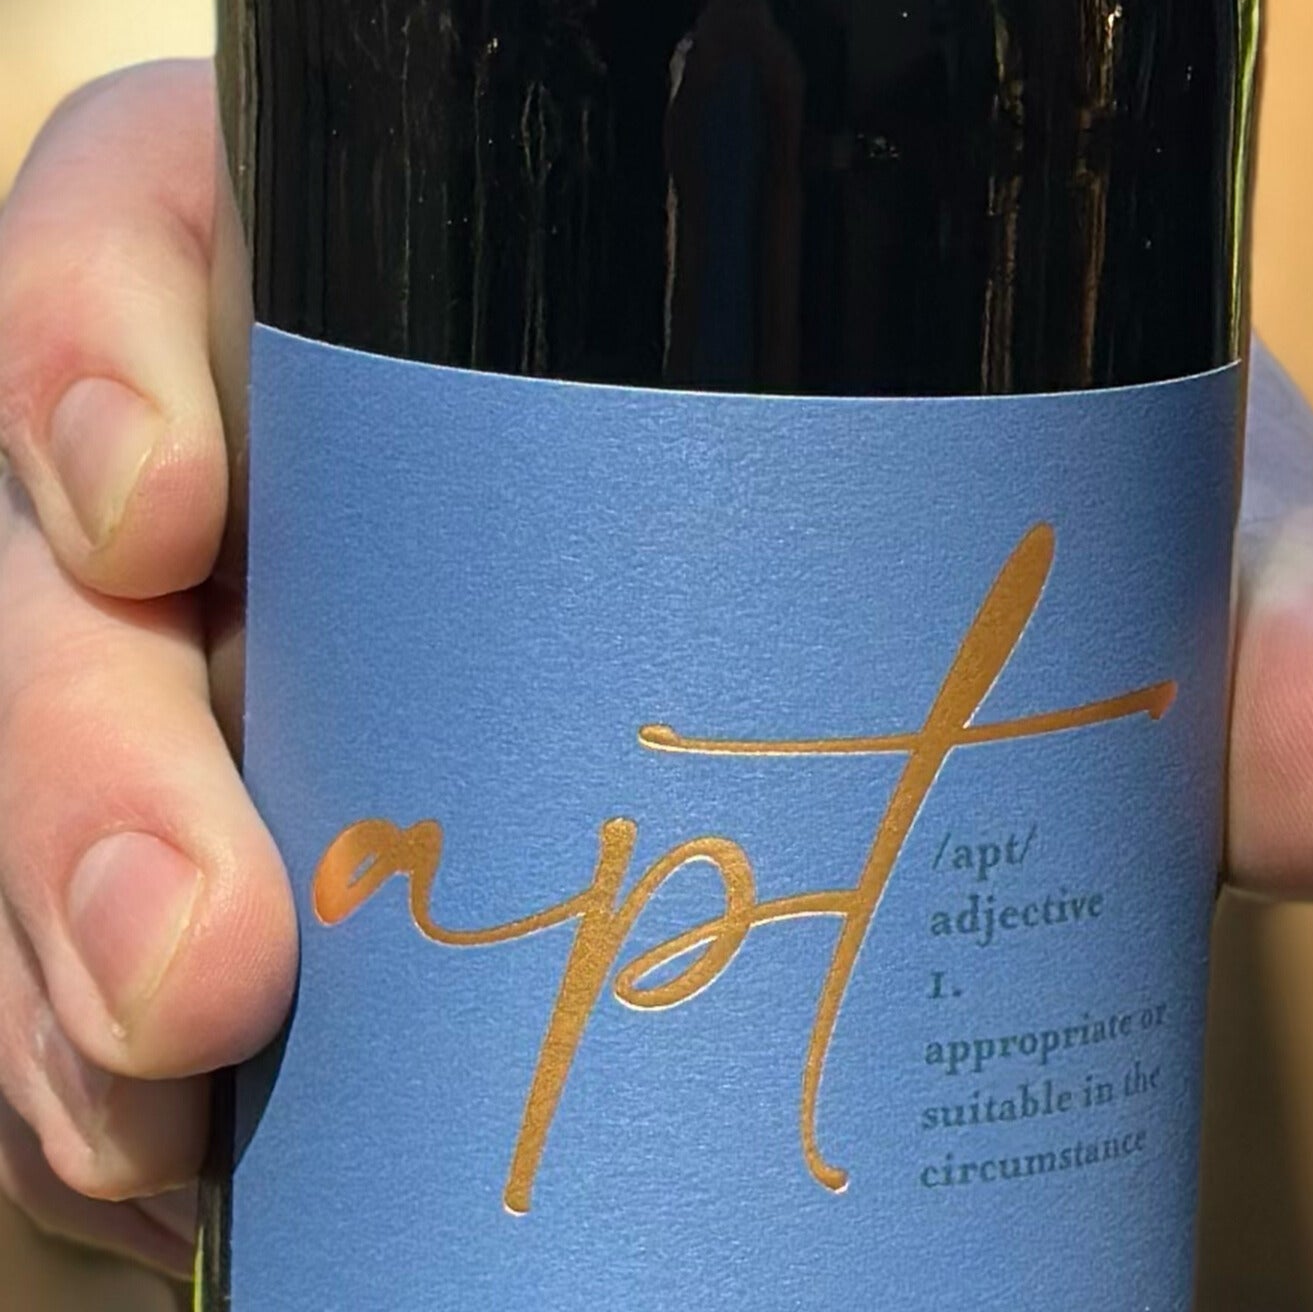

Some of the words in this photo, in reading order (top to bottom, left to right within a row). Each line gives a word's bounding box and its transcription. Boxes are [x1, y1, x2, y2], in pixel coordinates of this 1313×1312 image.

[312, 522, 1178, 1216] apt
[931, 824, 1038, 882] /apt/
[929, 887, 1104, 949] adjective
[924, 1011, 1132, 1076] appropriate
[1140, 1001, 1168, 1030] or
[921, 1079, 1073, 1131] suitable
[1081, 1075, 1115, 1107] in
[1124, 1059, 1163, 1099] the
[918, 1129, 1148, 1189] circumstance
